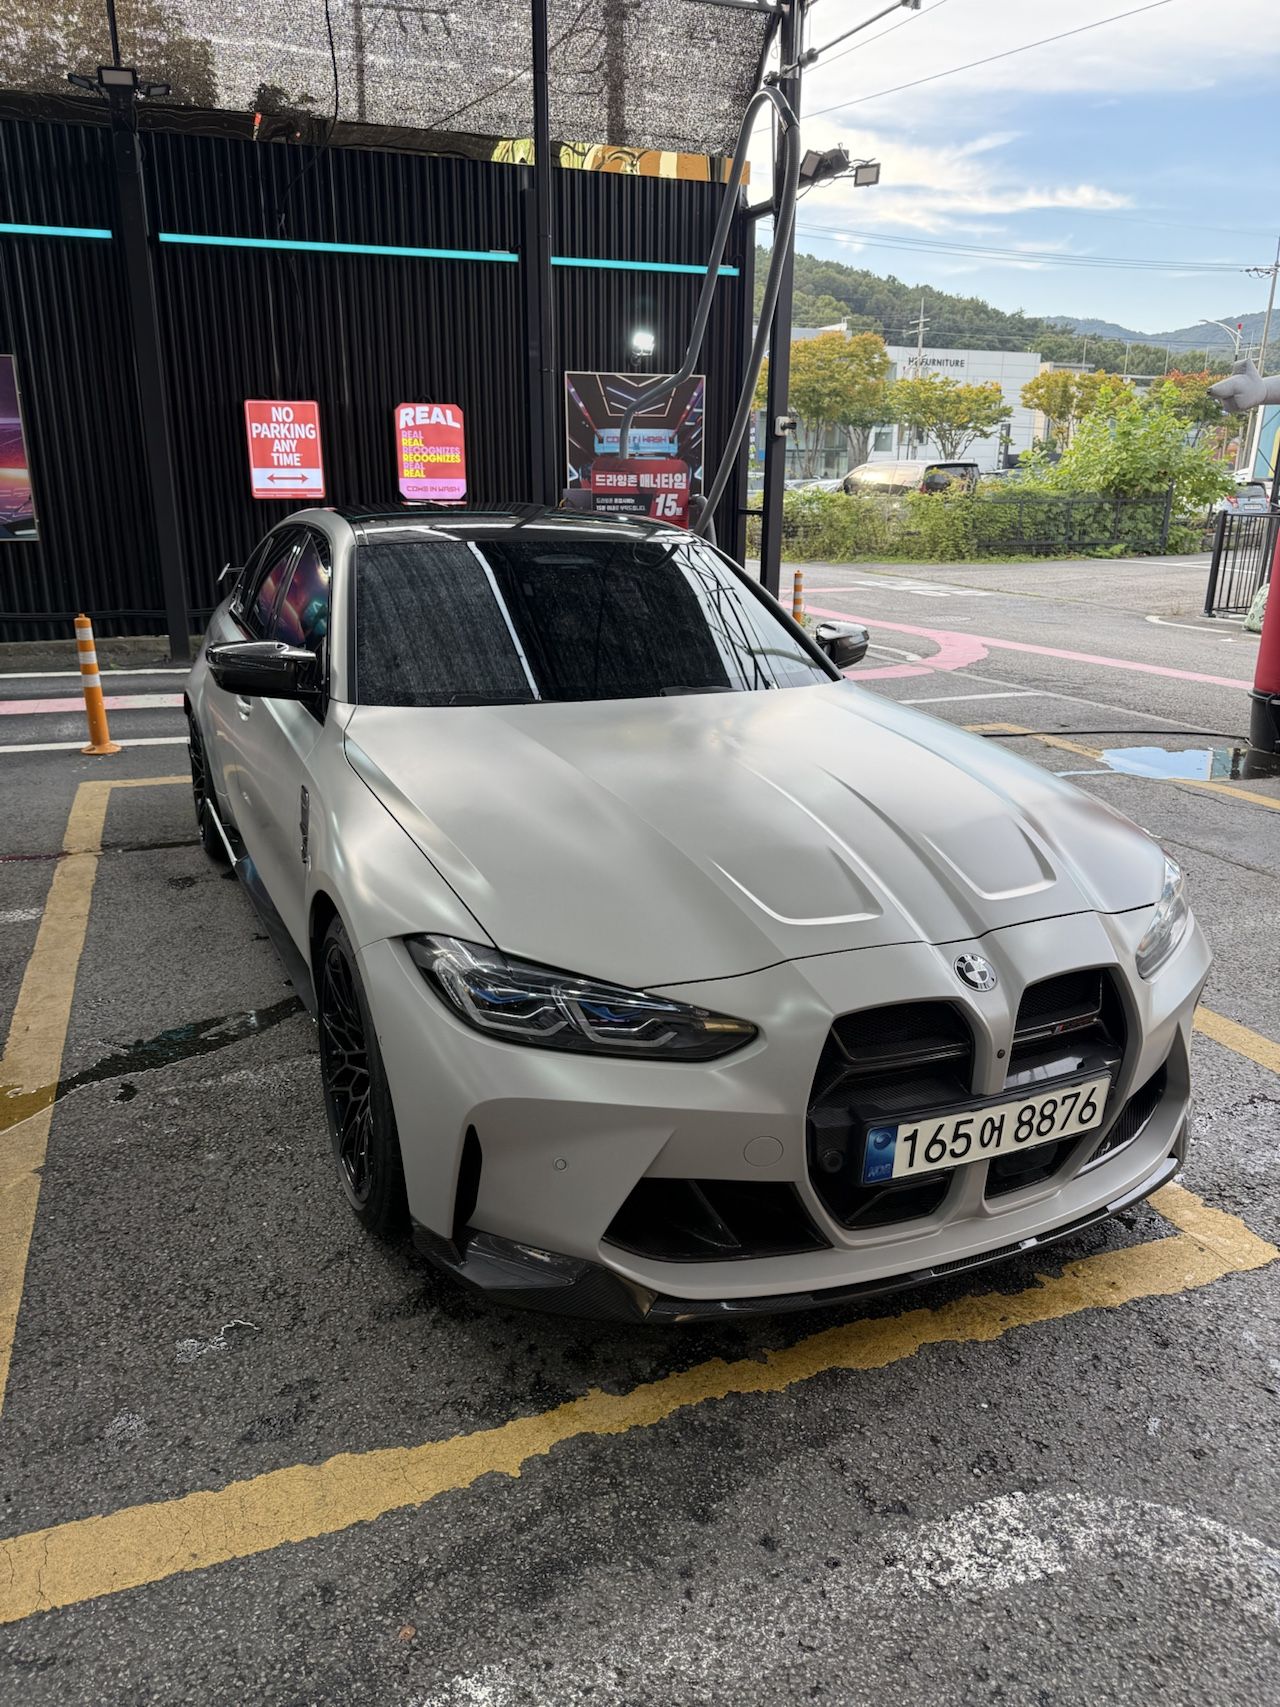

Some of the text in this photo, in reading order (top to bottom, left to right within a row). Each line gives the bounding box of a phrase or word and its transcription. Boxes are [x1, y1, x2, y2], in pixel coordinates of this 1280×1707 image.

[271, 406, 294, 422] NO
[400, 406, 461, 429] REAL
[251, 423, 316, 439] PARKING
[402, 430, 424, 438] REAL
[273, 439, 297, 452] ANY
[402, 438, 424, 446] REAL
[402, 446, 460, 454] RECOGNIZES
[271, 453, 302, 466] TIME
[403, 454, 461, 463] RECOGNIZES
[404, 469, 426, 477] REAL
[595, 473, 687, 489] 드라잉존 매너타임
[903, 1087, 1097, 1168] 165어 8876
